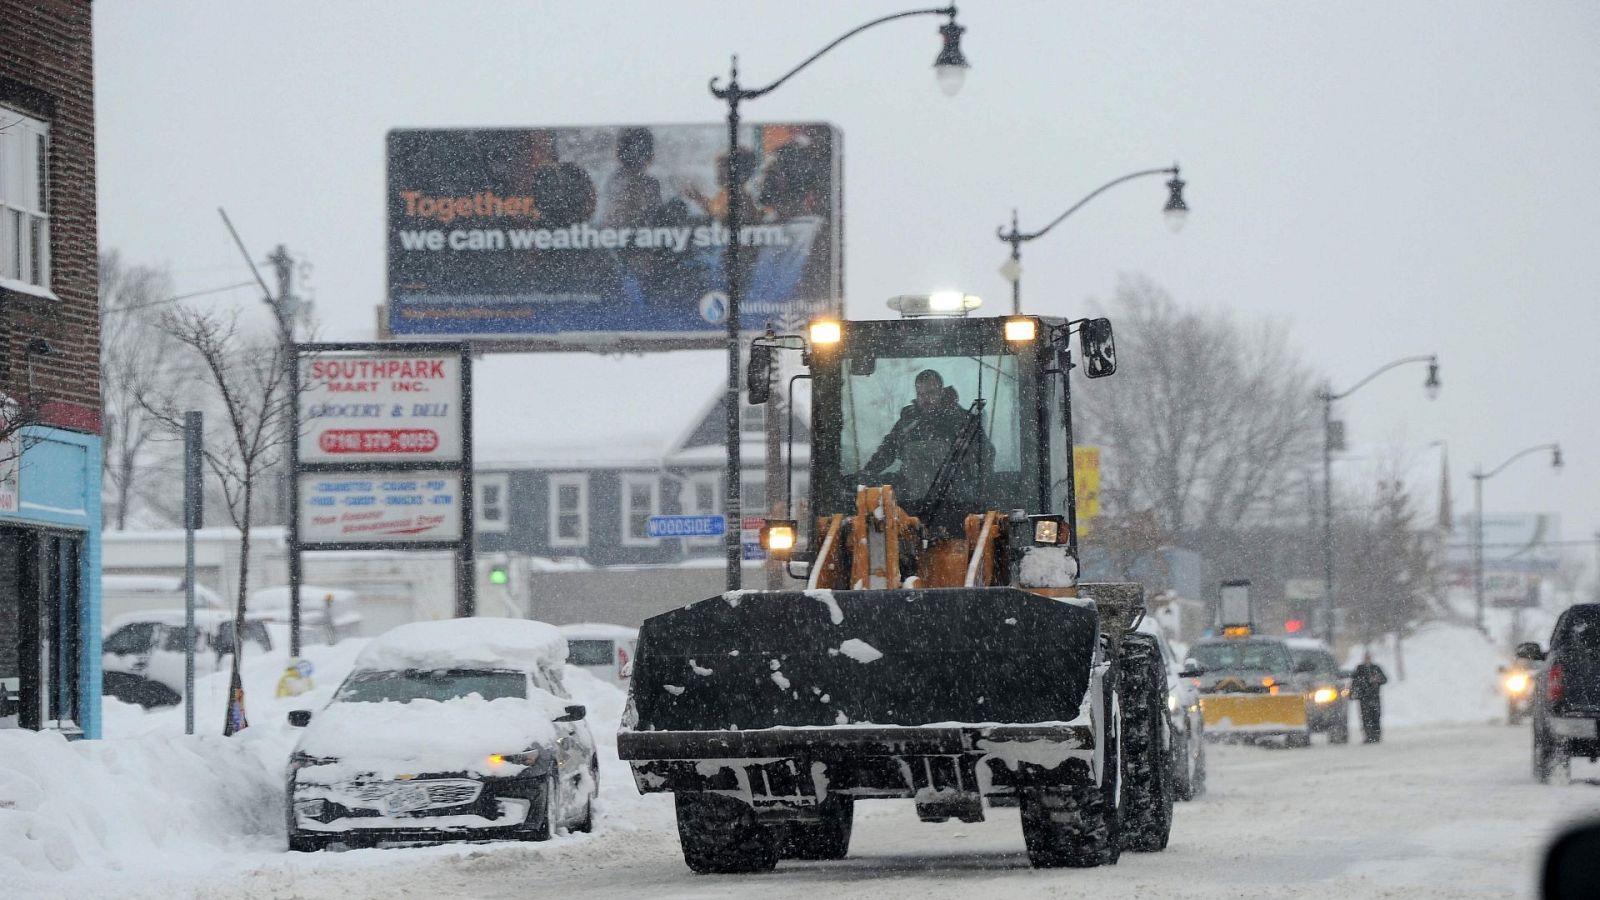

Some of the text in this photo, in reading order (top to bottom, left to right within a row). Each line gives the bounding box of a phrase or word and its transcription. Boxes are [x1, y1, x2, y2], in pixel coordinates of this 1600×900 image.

[401, 190, 540, 222] Together.
[400, 229, 445, 250] we
[450, 229, 504, 250] can
[508, 222, 633, 250] weather
[634, 227, 692, 253] any
[312, 360, 445, 379] SOUTHPARK
[327, 381, 430, 392] MART INC.
[308, 403, 449, 418] GROCERY & DELI
[649, 519, 712, 533] WOODSIDE
